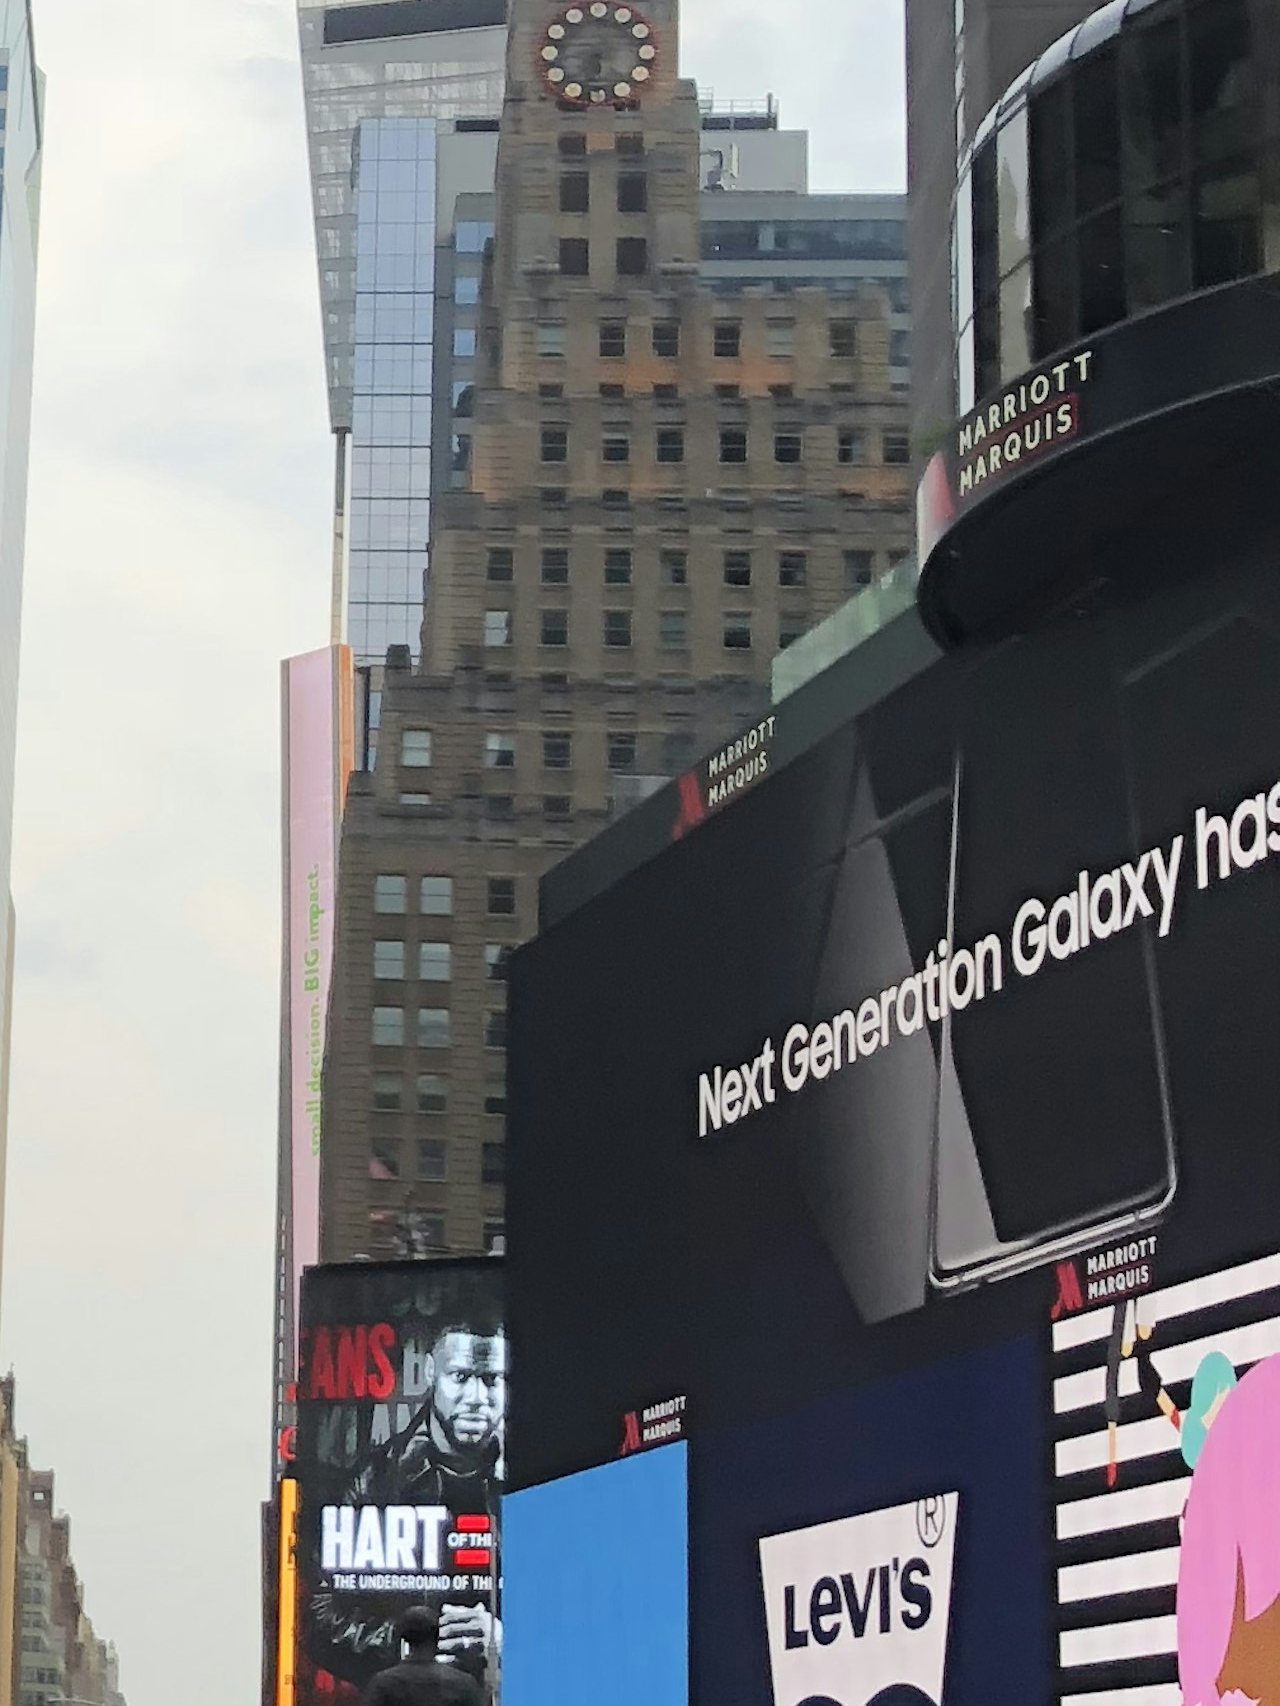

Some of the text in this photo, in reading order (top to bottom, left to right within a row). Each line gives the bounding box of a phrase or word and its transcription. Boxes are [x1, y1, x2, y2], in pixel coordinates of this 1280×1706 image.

[960, 351, 1092, 456] MARRIOTT
[960, 404, 1072, 497] MARQUIS
[709, 716, 776, 777] MARRIOTT
[708, 751, 768, 807] MARQUIS
[304, 863, 325, 1156] small decision. BIG impact.
[698, 1038, 775, 1137] Next
[781, 933, 1002, 1092] Generation
[1011, 834, 1184, 977] Galaxy
[1087, 1236, 1157, 1275] MARRIOTT
[1088, 1265, 1149, 1300] MARQUIS
[643, 1396, 686, 1422] MARRIOTT
[643, 1418, 680, 1441] MARQUIS
[321, 1505, 447, 1570] HART
[447, 1533, 469, 1547] OF
[333, 1574, 470, 1590] THE UNDERGROUND OF
